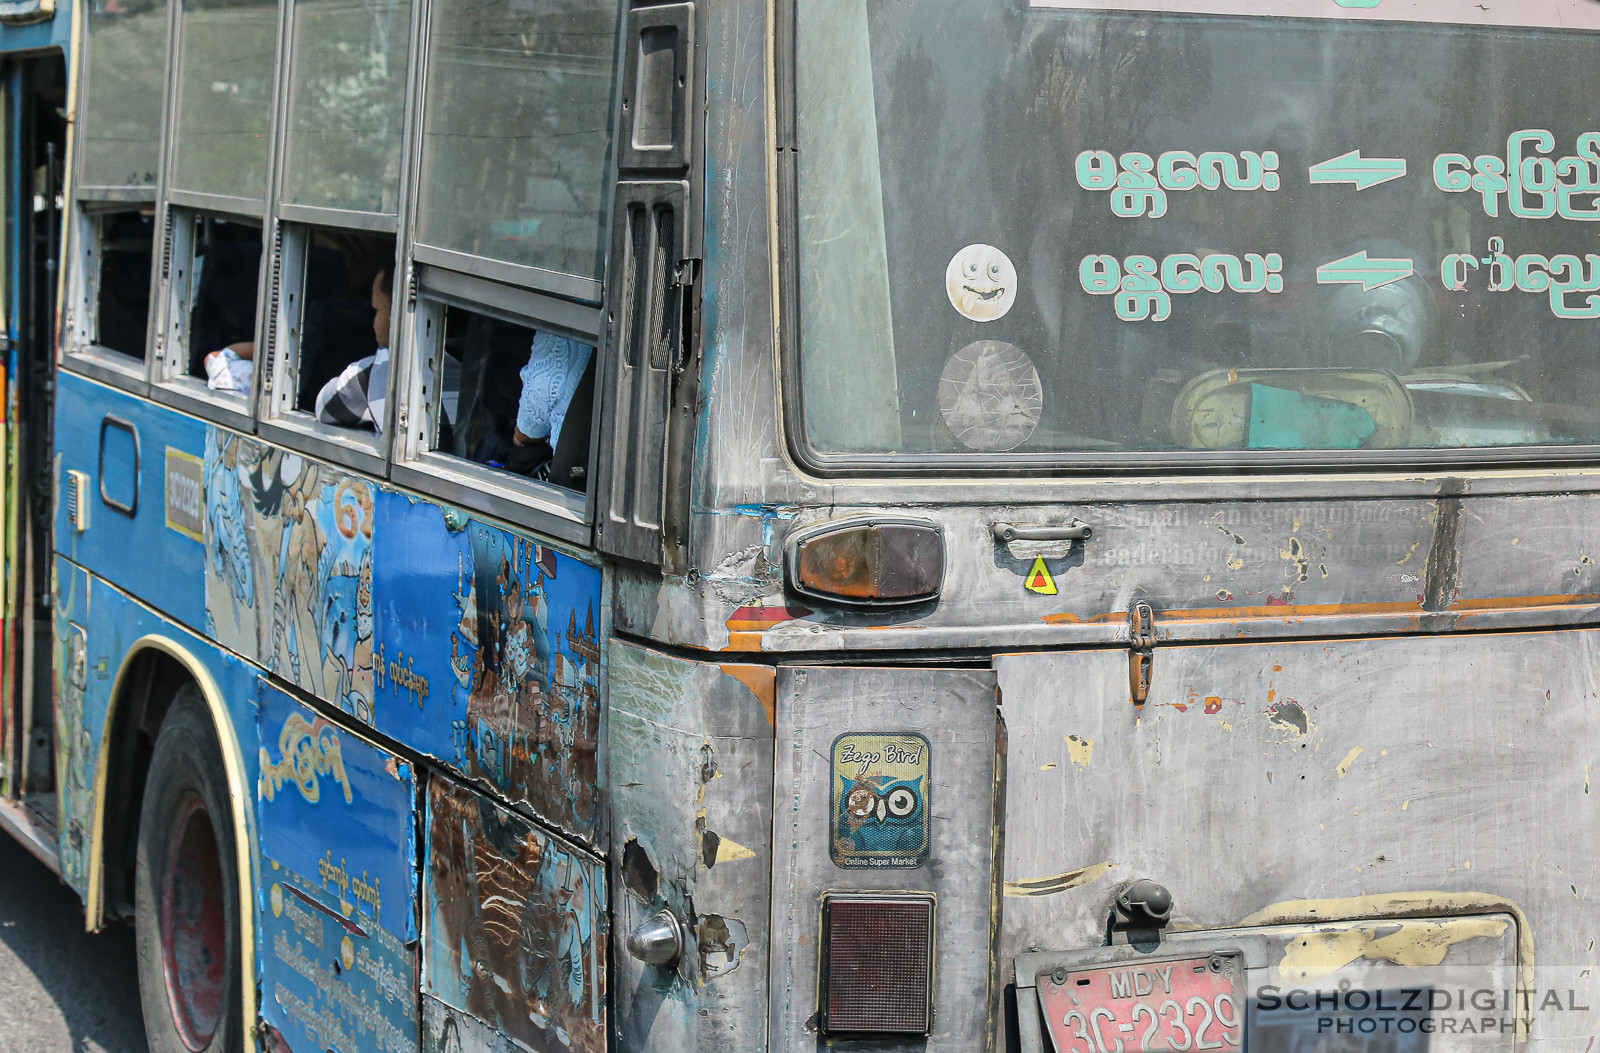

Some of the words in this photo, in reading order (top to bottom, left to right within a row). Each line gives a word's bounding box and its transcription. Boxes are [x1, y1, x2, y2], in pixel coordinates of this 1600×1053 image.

[1075, 151, 1280, 218] မန္တလေး
[1079, 253, 1283, 322] မန္တလေး
[840, 744, 880, 774] Zego
[884, 745, 922, 765] Bird
[845, 857, 868, 866] Online
[869, 857, 890, 868] Super
[891, 857, 917, 866] Market
[1109, 966, 1173, 999] MDY
[1063, 993, 1239, 1053] 3C-2329
